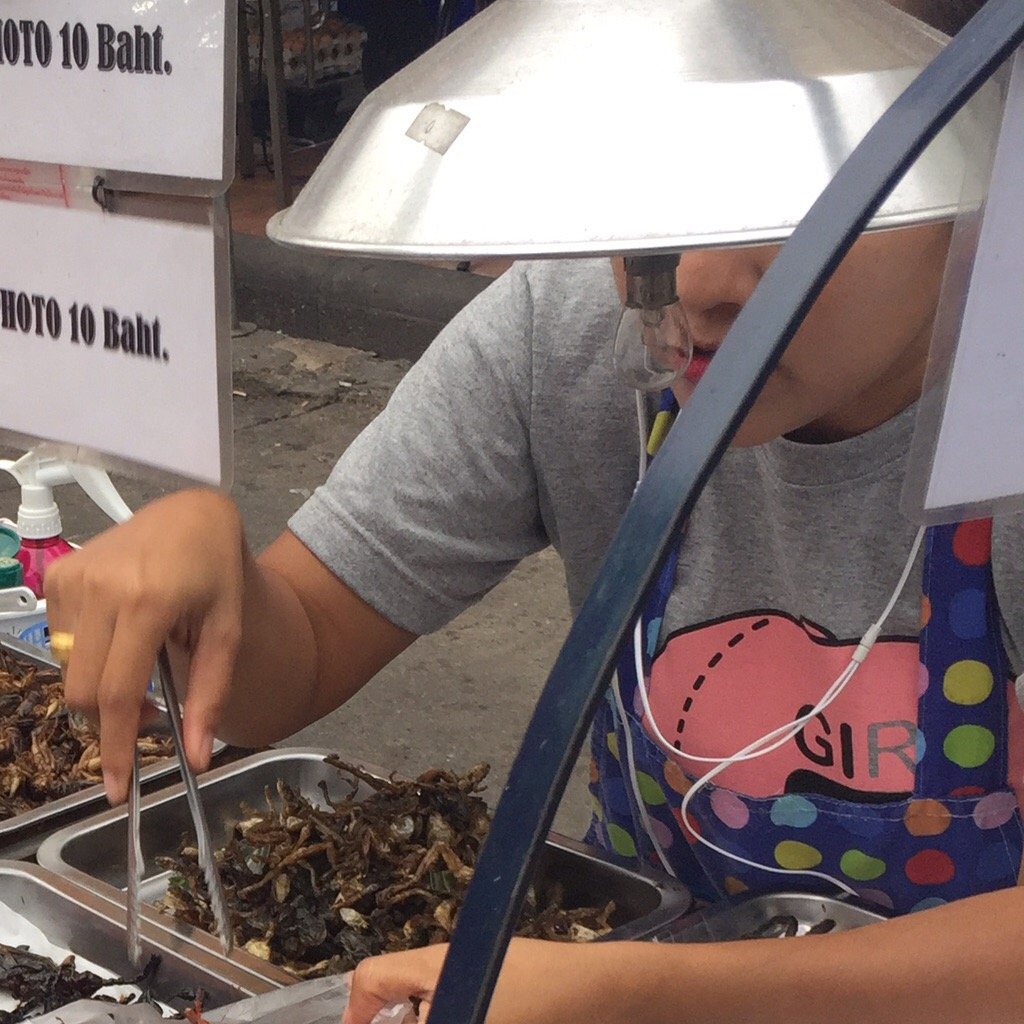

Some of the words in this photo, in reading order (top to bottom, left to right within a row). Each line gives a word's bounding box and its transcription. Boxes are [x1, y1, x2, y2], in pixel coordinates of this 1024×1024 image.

[59, 22, 89, 70] 10
[96, 23, 172, 75] Baht.
[68, 301, 96, 346] 10
[103, 306, 170, 362] Baht.
